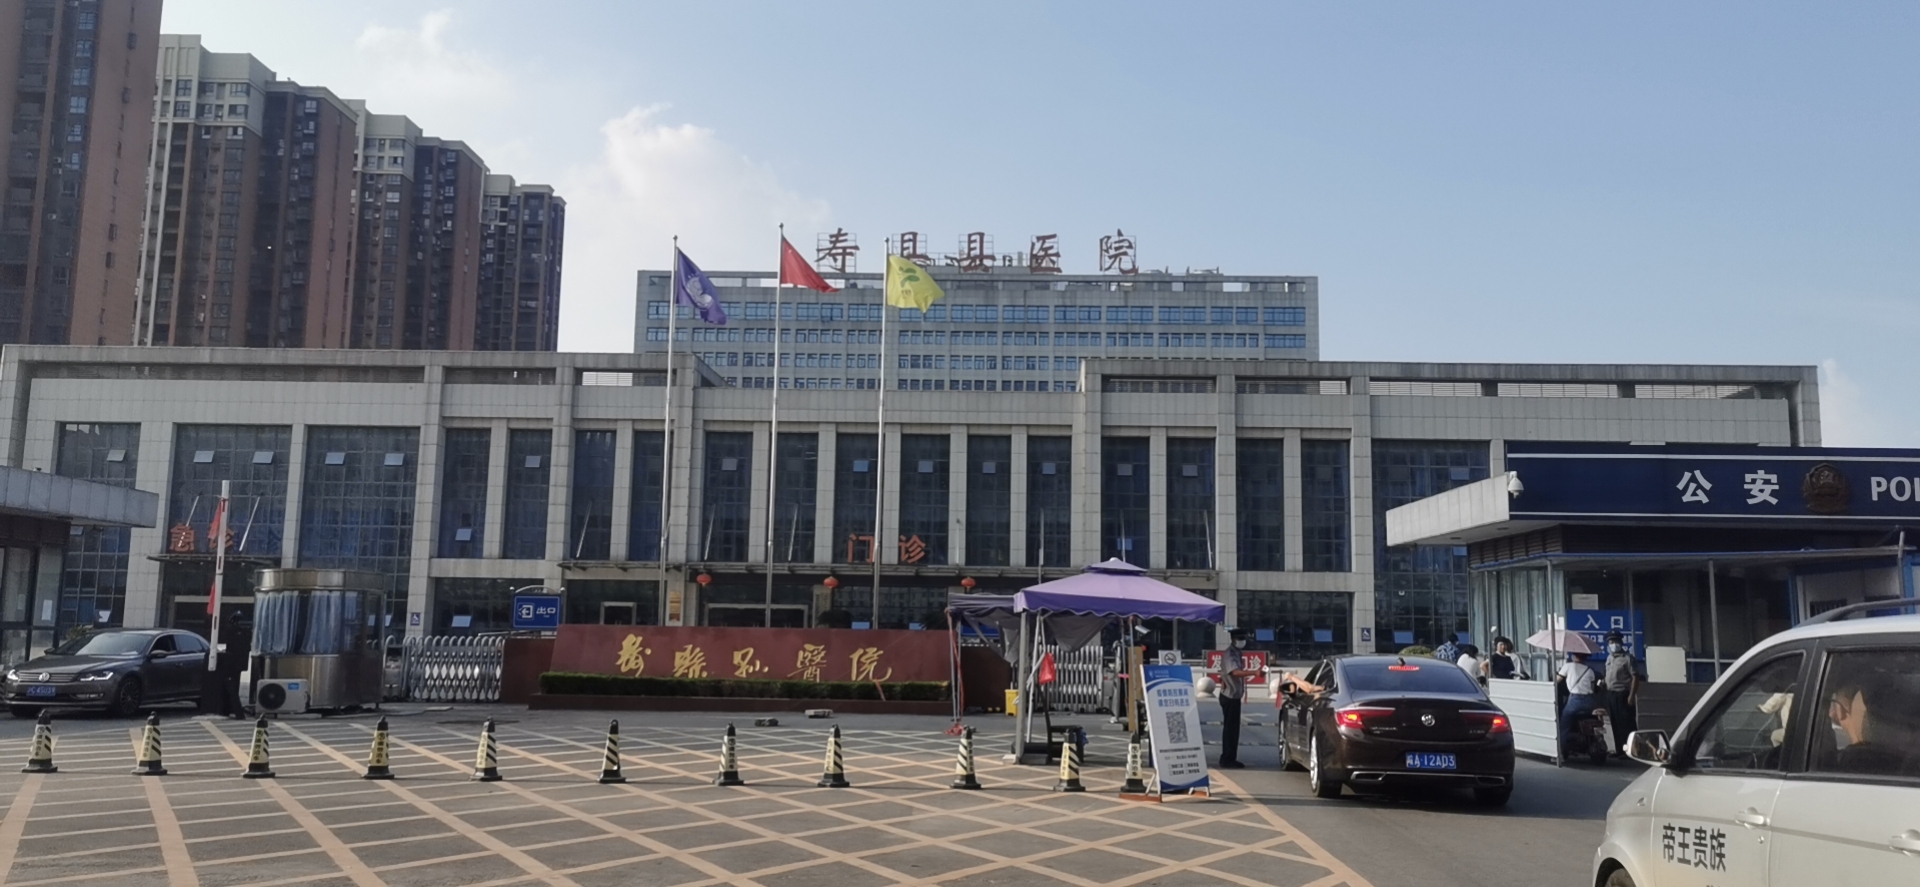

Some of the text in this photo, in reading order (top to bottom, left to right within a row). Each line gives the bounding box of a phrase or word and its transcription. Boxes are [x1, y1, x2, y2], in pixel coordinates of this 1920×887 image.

[1675, 469, 1780, 505] 公安
[847, 533, 926, 564] 门诊
[536, 606, 556, 615] 出口
[1583, 613, 1624, 630] 入口
[1662, 822, 1727, 872] 帝王贵族
